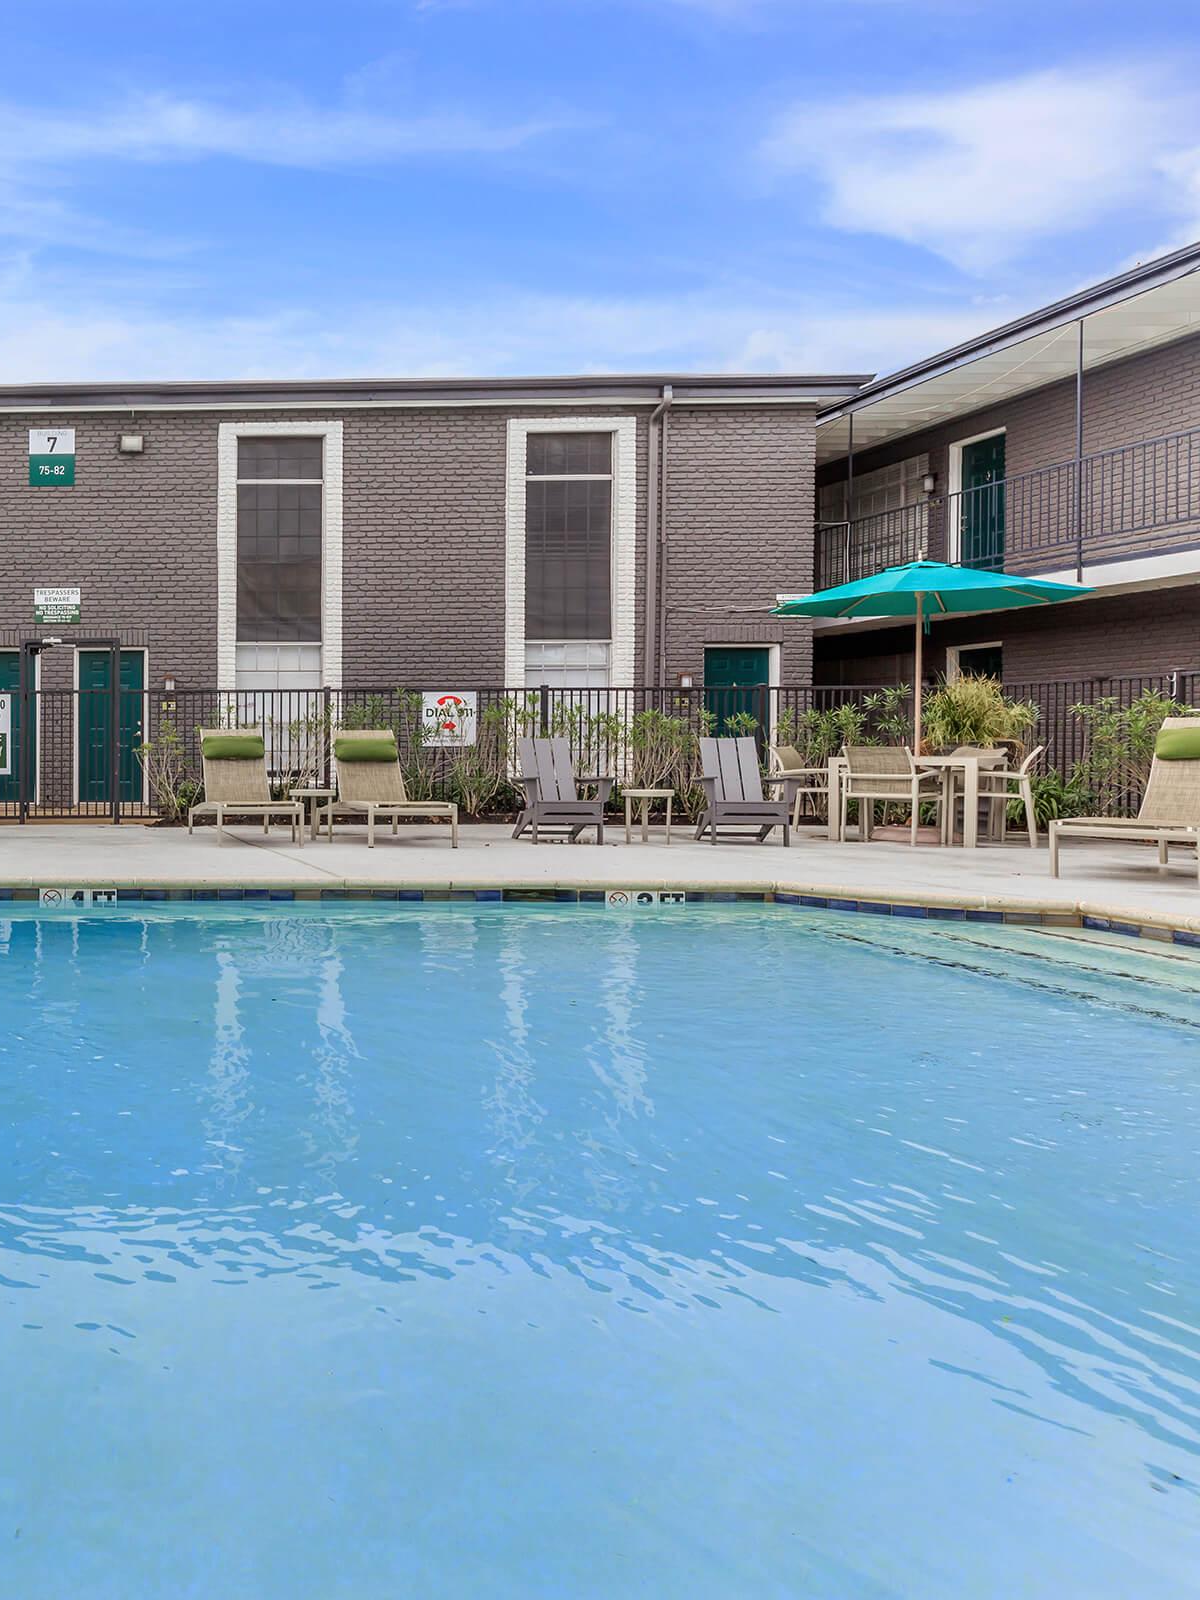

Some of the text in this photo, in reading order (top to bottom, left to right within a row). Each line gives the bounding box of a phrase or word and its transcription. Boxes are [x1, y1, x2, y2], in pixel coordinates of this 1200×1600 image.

[47, 436, 58, 453] 7
[39, 465, 65, 475] 75-82
[426, 708, 473, 718] DIAL 911
